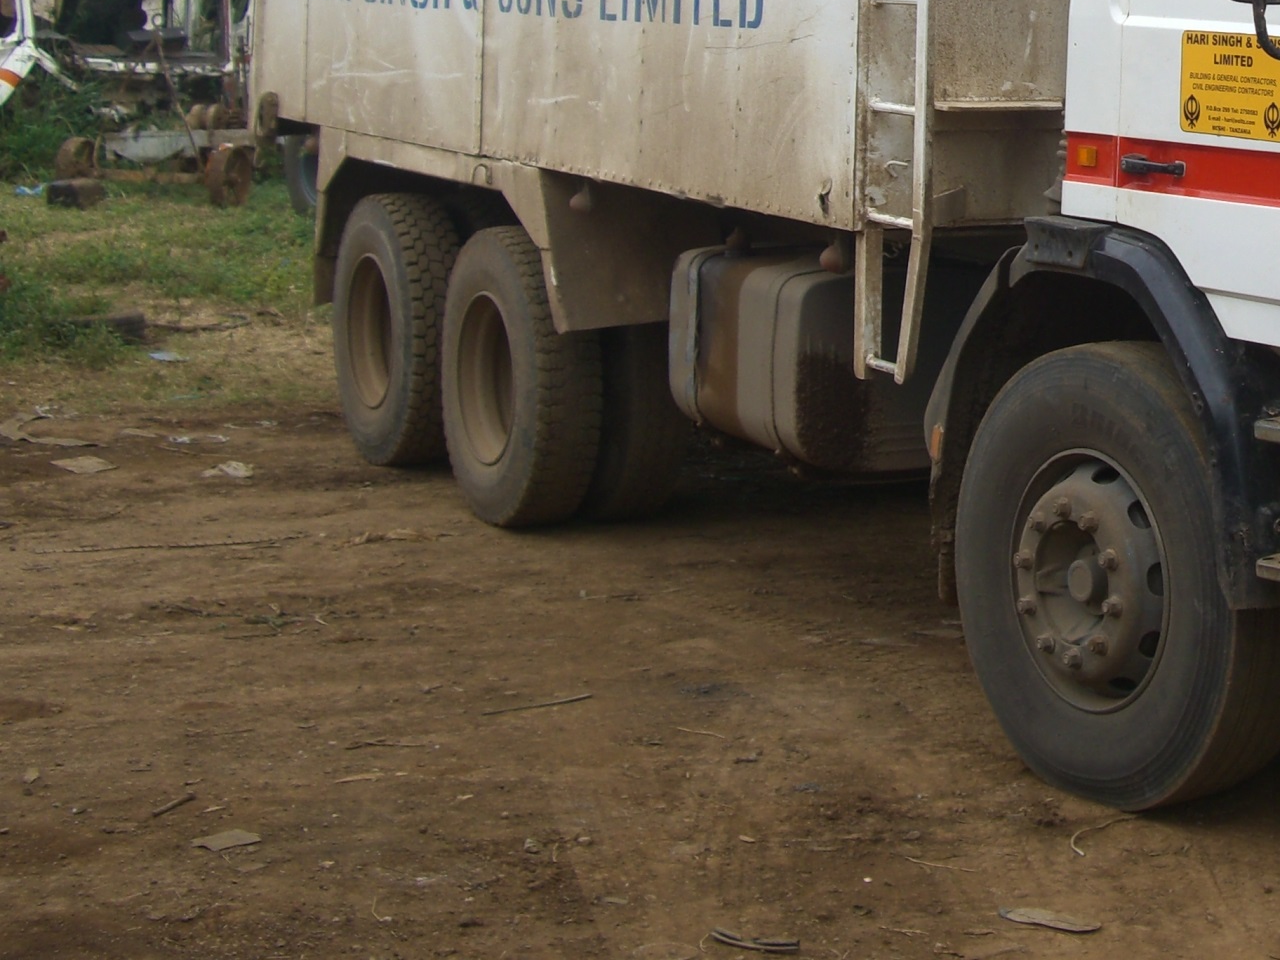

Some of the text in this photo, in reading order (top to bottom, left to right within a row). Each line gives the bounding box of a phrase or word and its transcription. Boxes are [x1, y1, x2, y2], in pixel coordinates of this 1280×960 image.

[1186, 33, 1209, 45] HARI
[1212, 34, 1242, 47] SINGH
[1246, 37, 1253, 48] &
[1213, 53, 1254, 67] LIMITED
[1189, 72, 1211, 80] BUILDING
[1217, 74, 1239, 83] GENERAL
[1192, 83, 1274, 97] CIVIL ENGINEERING CONTRACTORS
